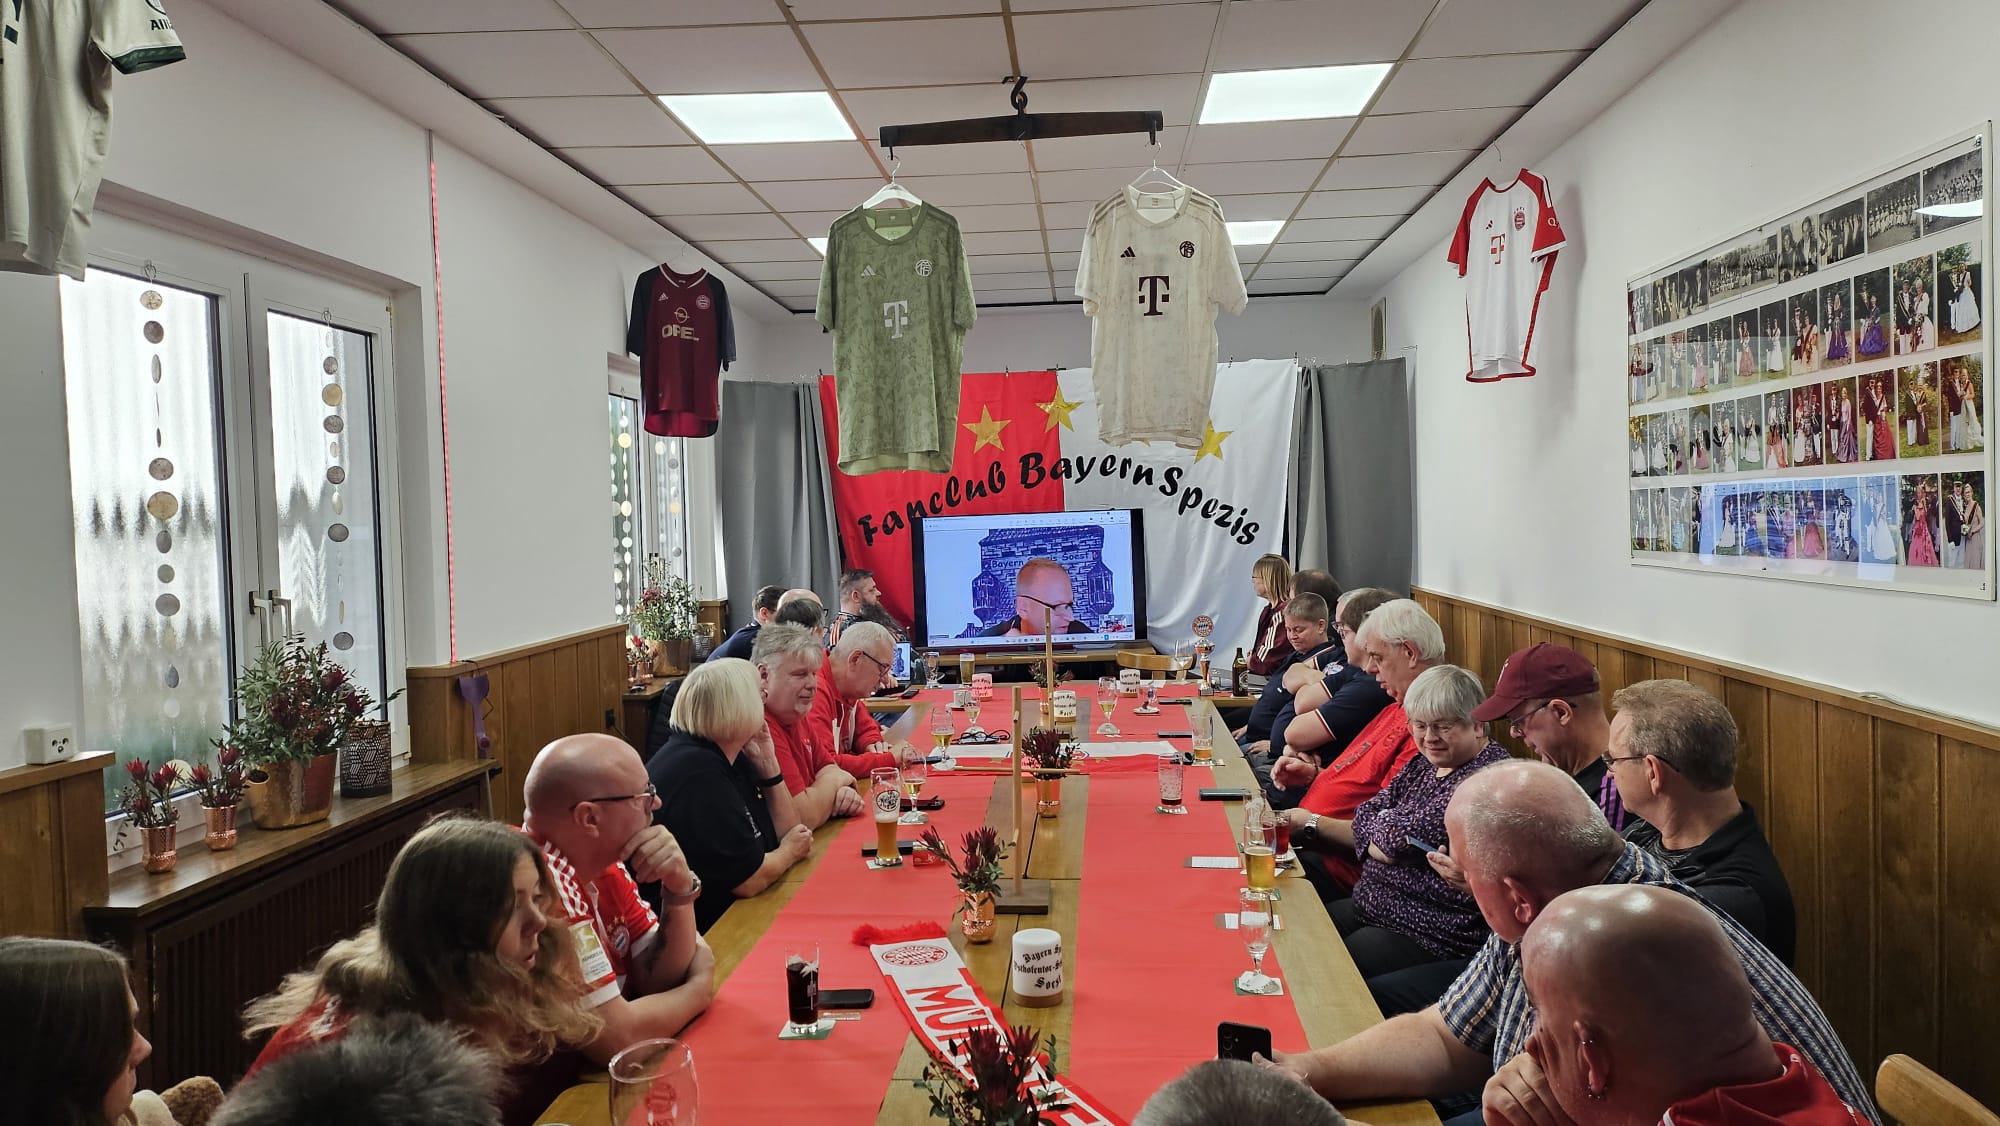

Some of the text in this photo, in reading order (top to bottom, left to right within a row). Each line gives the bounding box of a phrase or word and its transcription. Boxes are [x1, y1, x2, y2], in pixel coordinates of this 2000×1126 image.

[1138, 275, 1170, 316] T
[661, 324, 700, 342] OPEL
[883, 300, 908, 339] T
[857, 461, 1006, 546] Fanclub
[1022, 948, 1053, 964] Bayern
